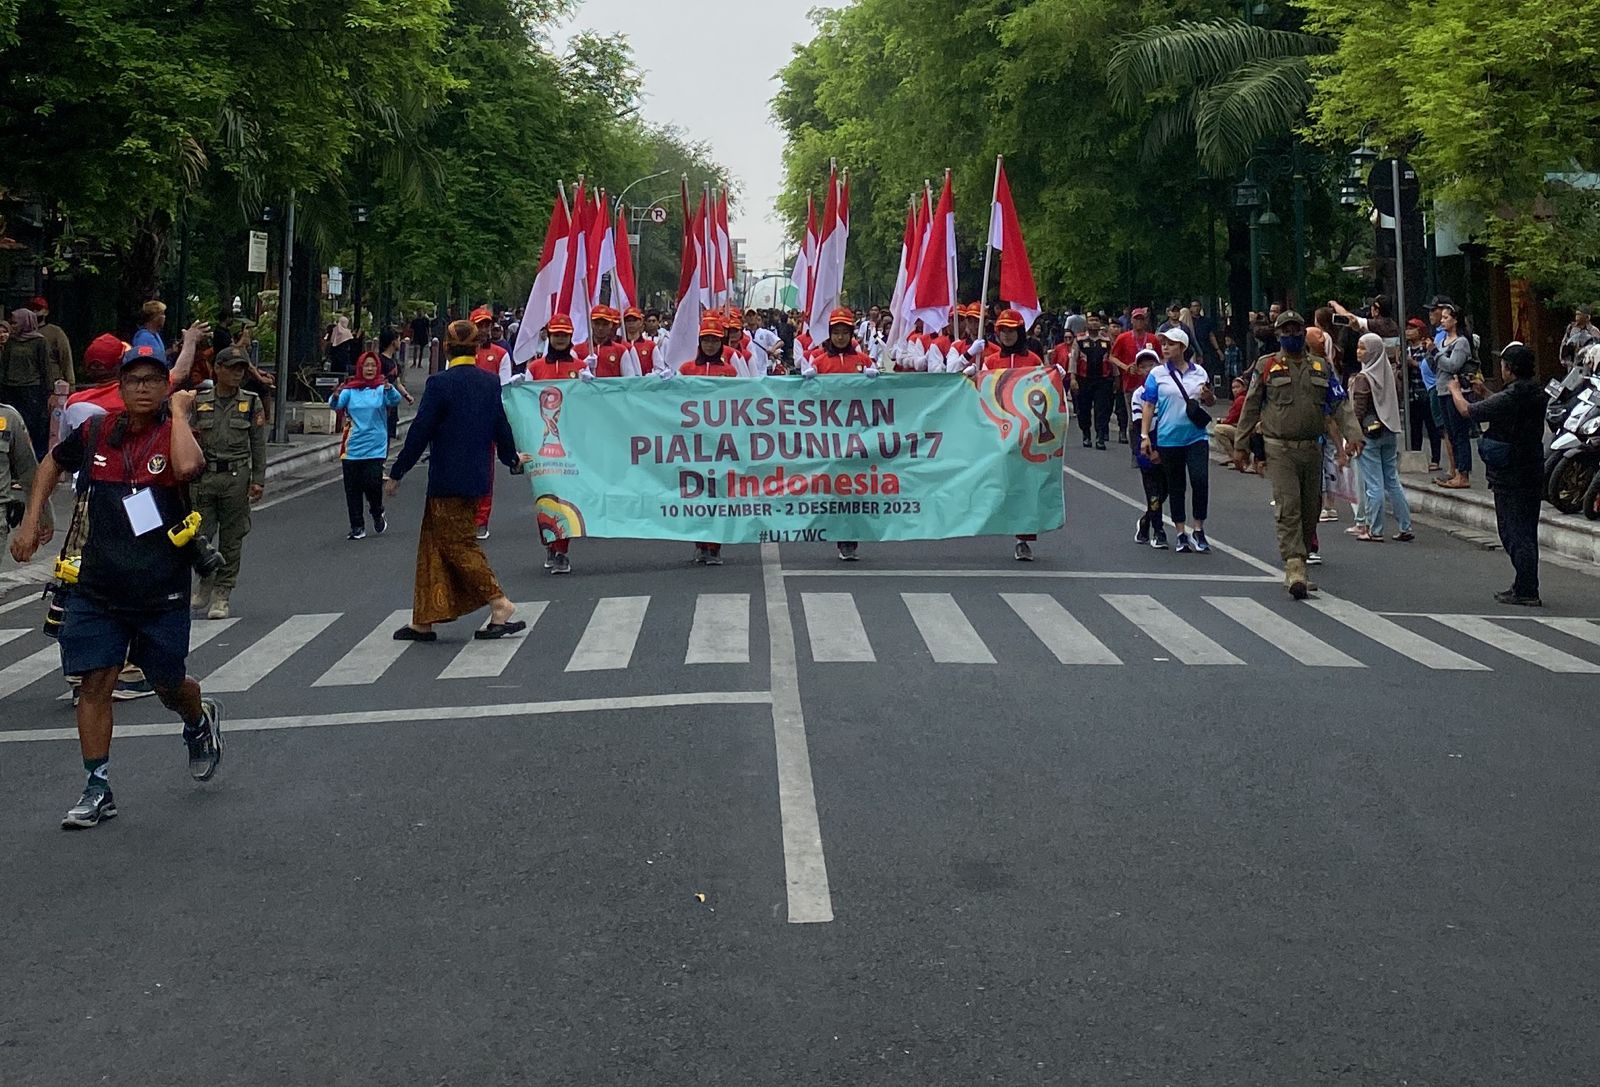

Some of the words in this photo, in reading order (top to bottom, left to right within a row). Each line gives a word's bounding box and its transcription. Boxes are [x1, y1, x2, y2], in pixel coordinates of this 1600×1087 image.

[680, 397, 895, 428] SUKSESKAN
[630, 433, 740, 465] PIALA
[750, 431, 869, 461] DUNIA
[877, 431, 944, 460] U17
[679, 469, 717, 498] Di
[727, 464, 900, 498] Indonesia
[660, 504, 679, 517] 10
[683, 503, 772, 517] NOVEMBER
[785, 502, 794, 515] 2
[798, 501, 880, 515] DESEMBER
[883, 501, 921, 515] 2023
[759, 528, 828, 542] #U17WC
